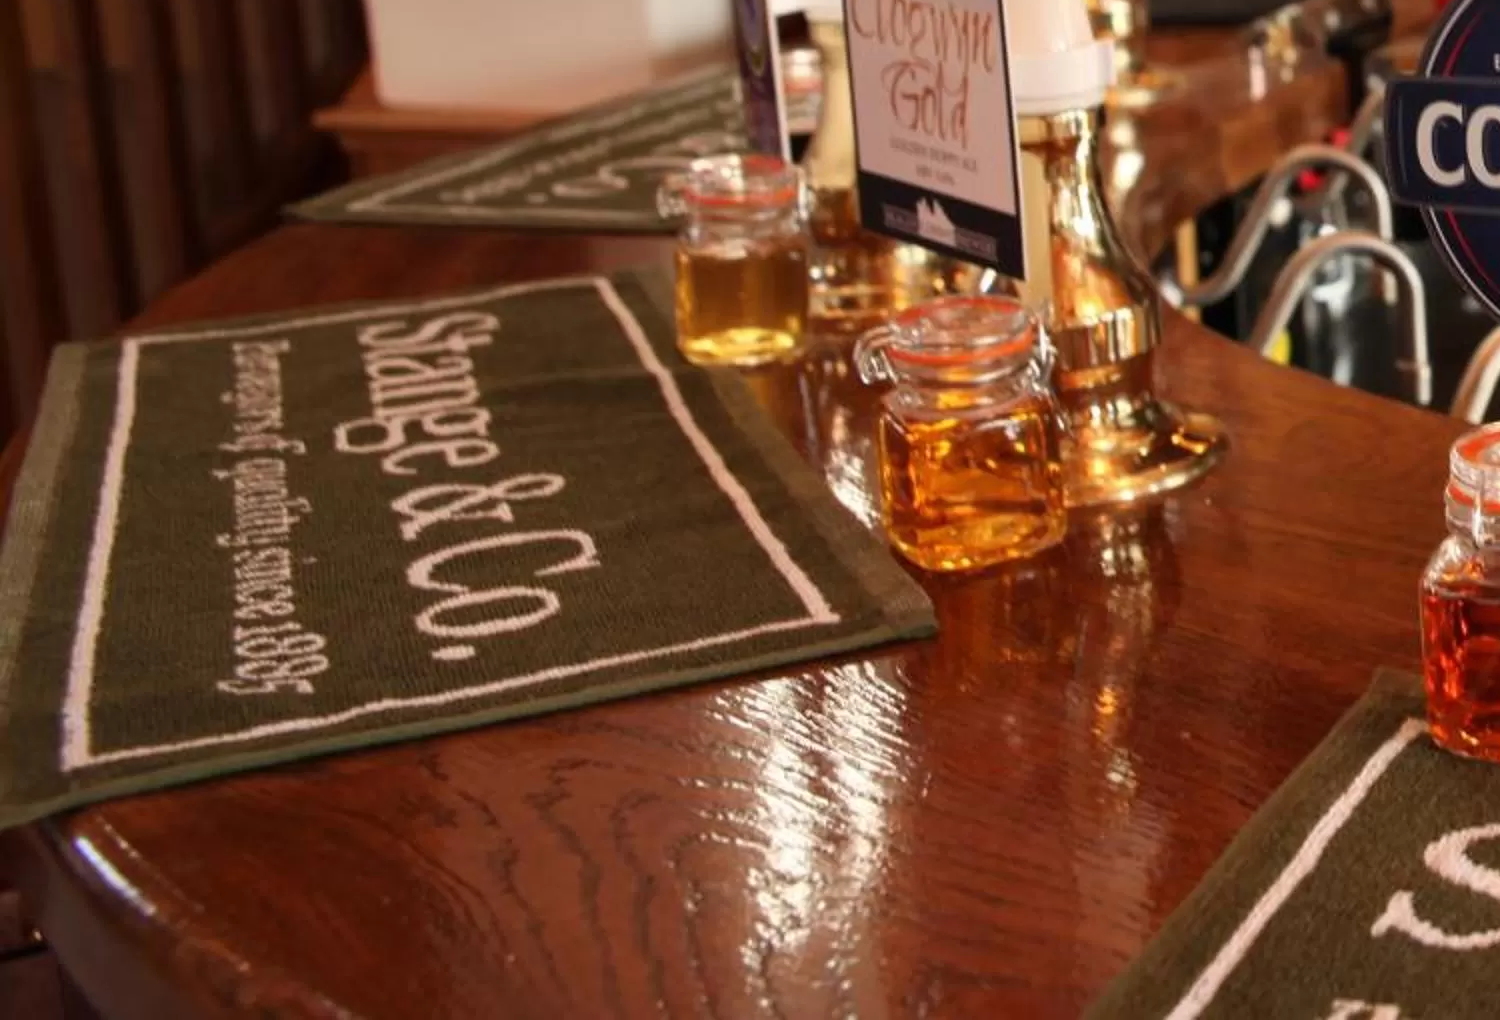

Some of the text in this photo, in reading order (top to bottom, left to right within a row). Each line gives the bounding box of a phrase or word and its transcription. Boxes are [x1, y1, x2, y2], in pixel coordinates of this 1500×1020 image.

[882, 57, 970, 149] Gold
[335, 311, 600, 661] Stange & Co.
[232, 546, 318, 620] since
[216, 621, 331, 695] 1885
